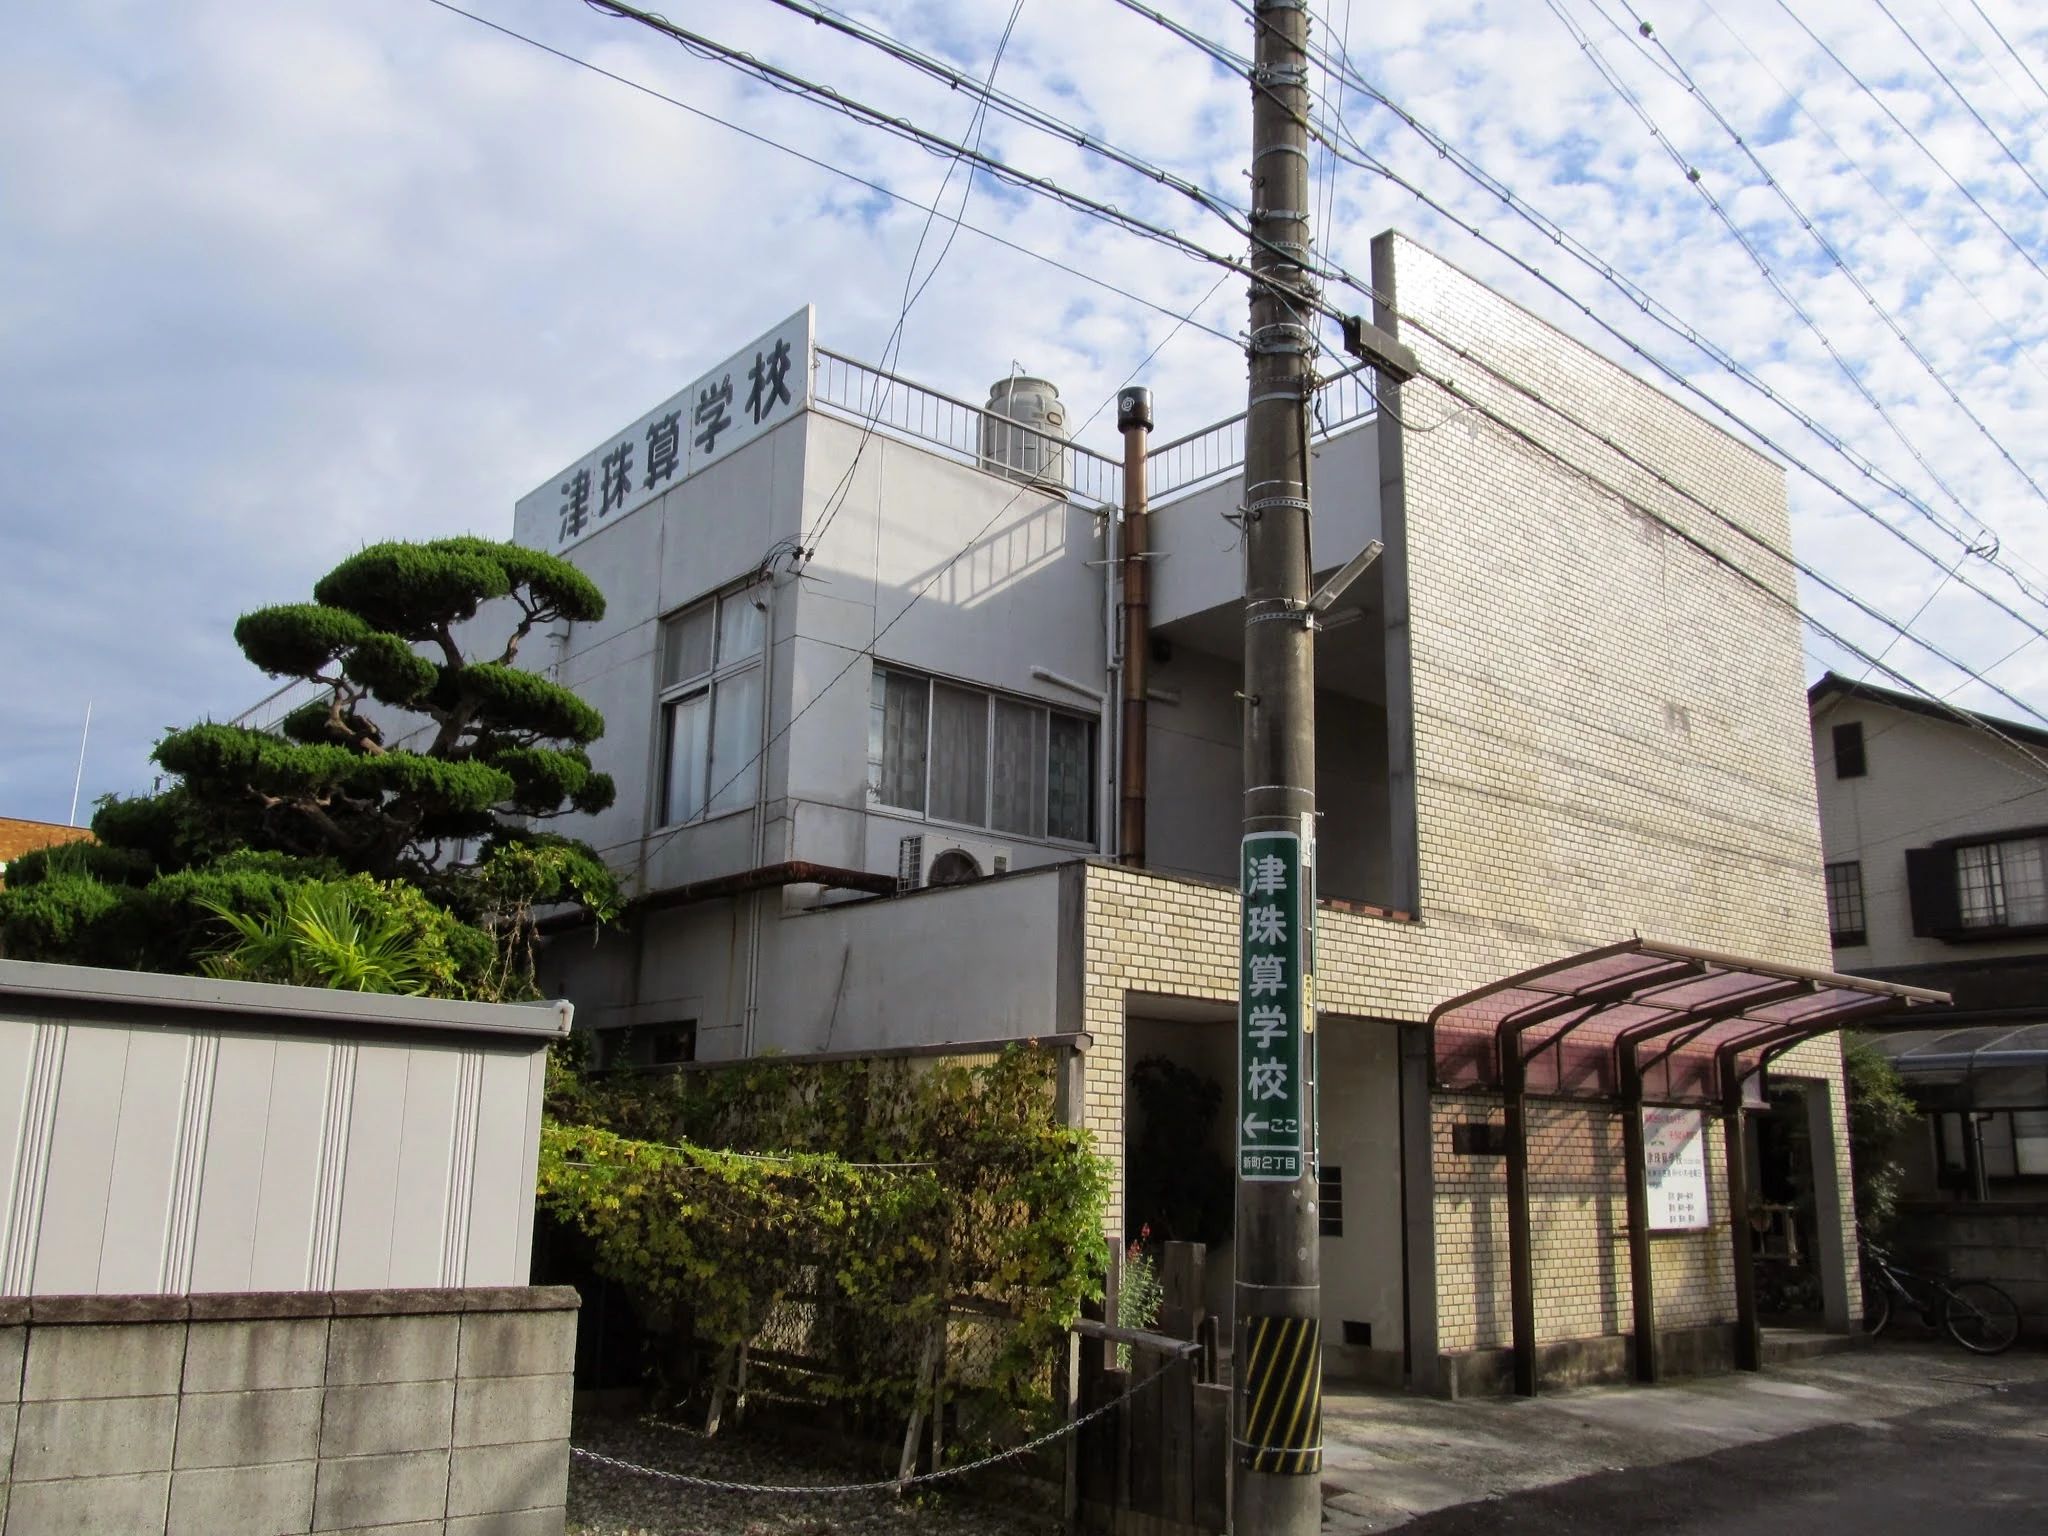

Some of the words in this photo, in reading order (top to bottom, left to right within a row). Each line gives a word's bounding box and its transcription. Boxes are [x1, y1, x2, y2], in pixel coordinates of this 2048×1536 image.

[558, 338, 791, 544] 津珠算学校
[1247, 854, 1288, 1101] 津珠算学校
[1243, 1156, 1296, 1170] 新町2丁目
[1270, 1118, 1298, 1133] ここ
